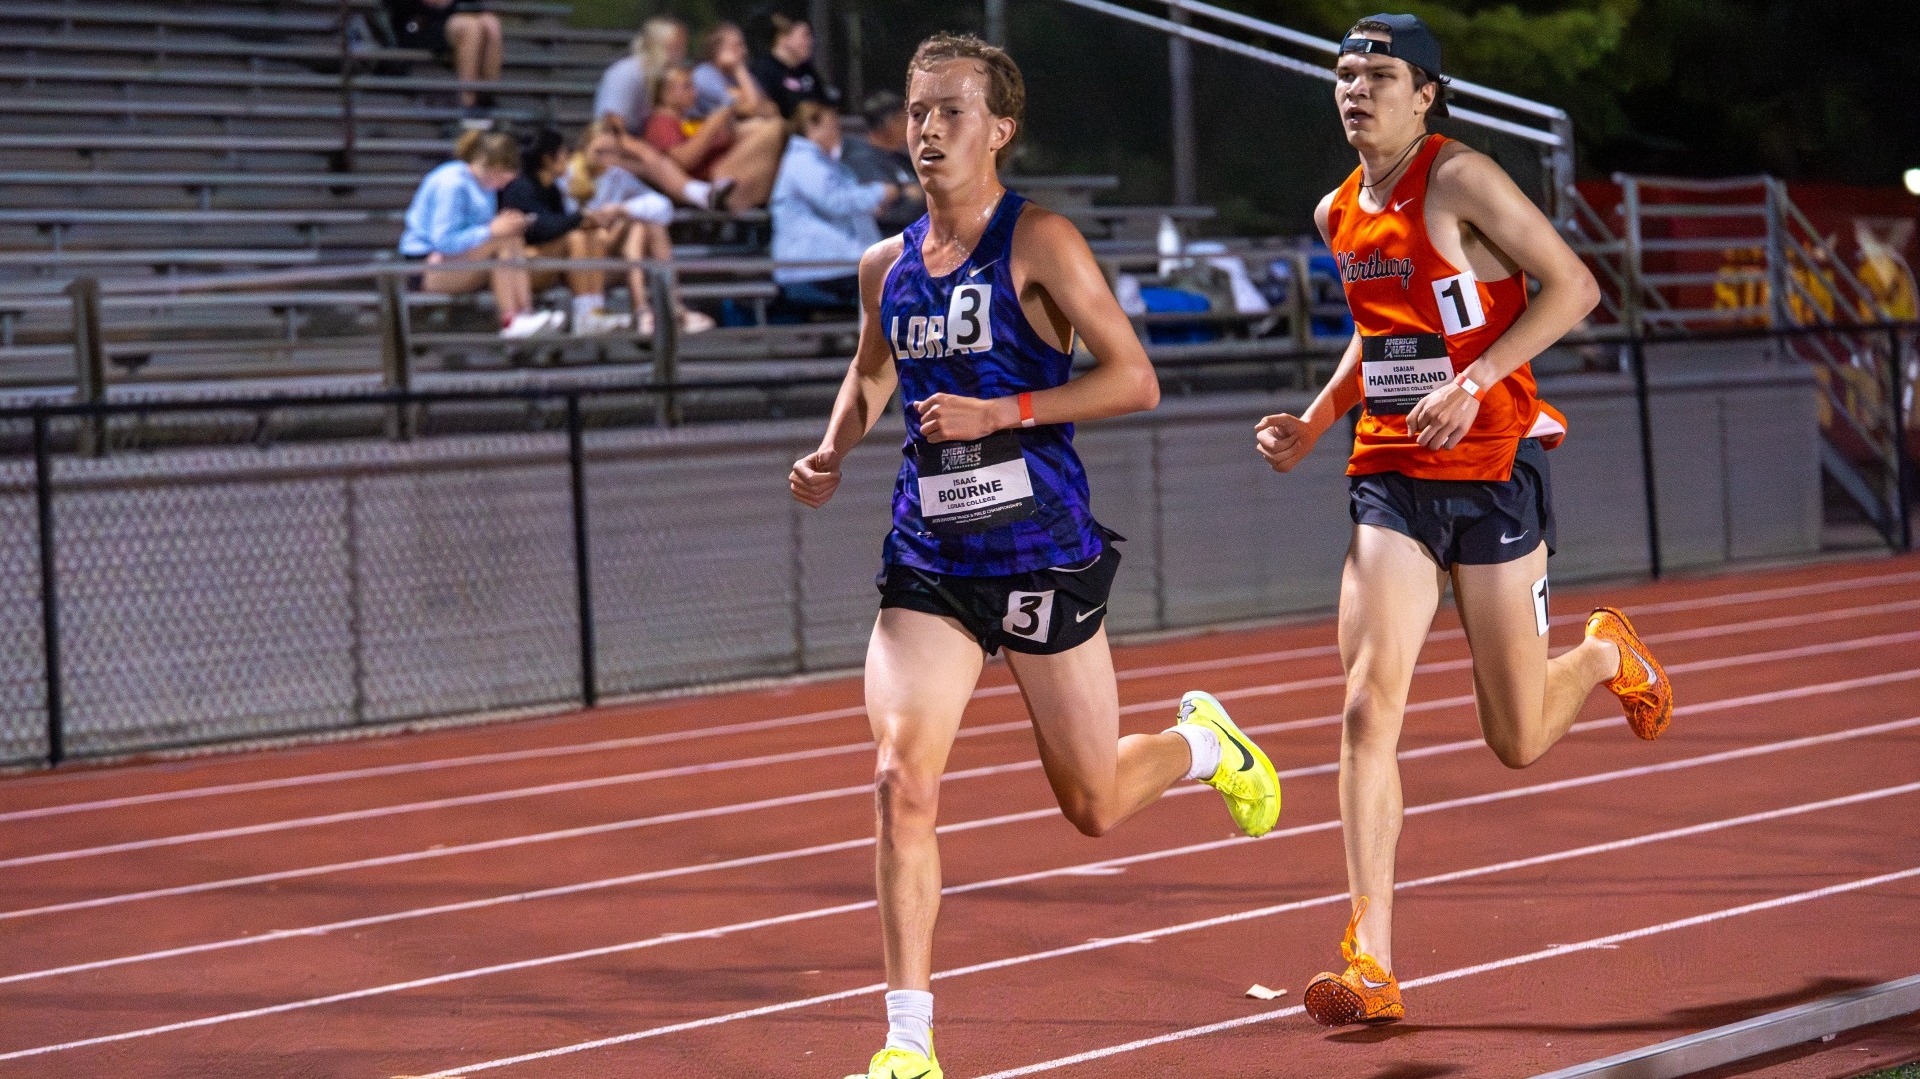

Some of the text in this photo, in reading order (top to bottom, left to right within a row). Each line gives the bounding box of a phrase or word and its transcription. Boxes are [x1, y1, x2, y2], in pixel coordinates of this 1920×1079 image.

[1337, 248, 1415, 290] Wartburg
[956, 287, 982, 346] 3
[1441, 278, 1471, 328] 1
[891, 315, 993, 360] LOR
[1385, 337, 1418, 346] AMERICAN
[1368, 371, 1447, 387] HAMMERAND
[1393, 365, 1415, 373] ISAIAH
[938, 480, 1004, 503] BOURNE
[953, 476, 978, 487] ISAAC
[947, 495, 997, 510] LORAS COLLEGE
[1012, 595, 1043, 636] 3
[1538, 579, 1549, 626] 1
